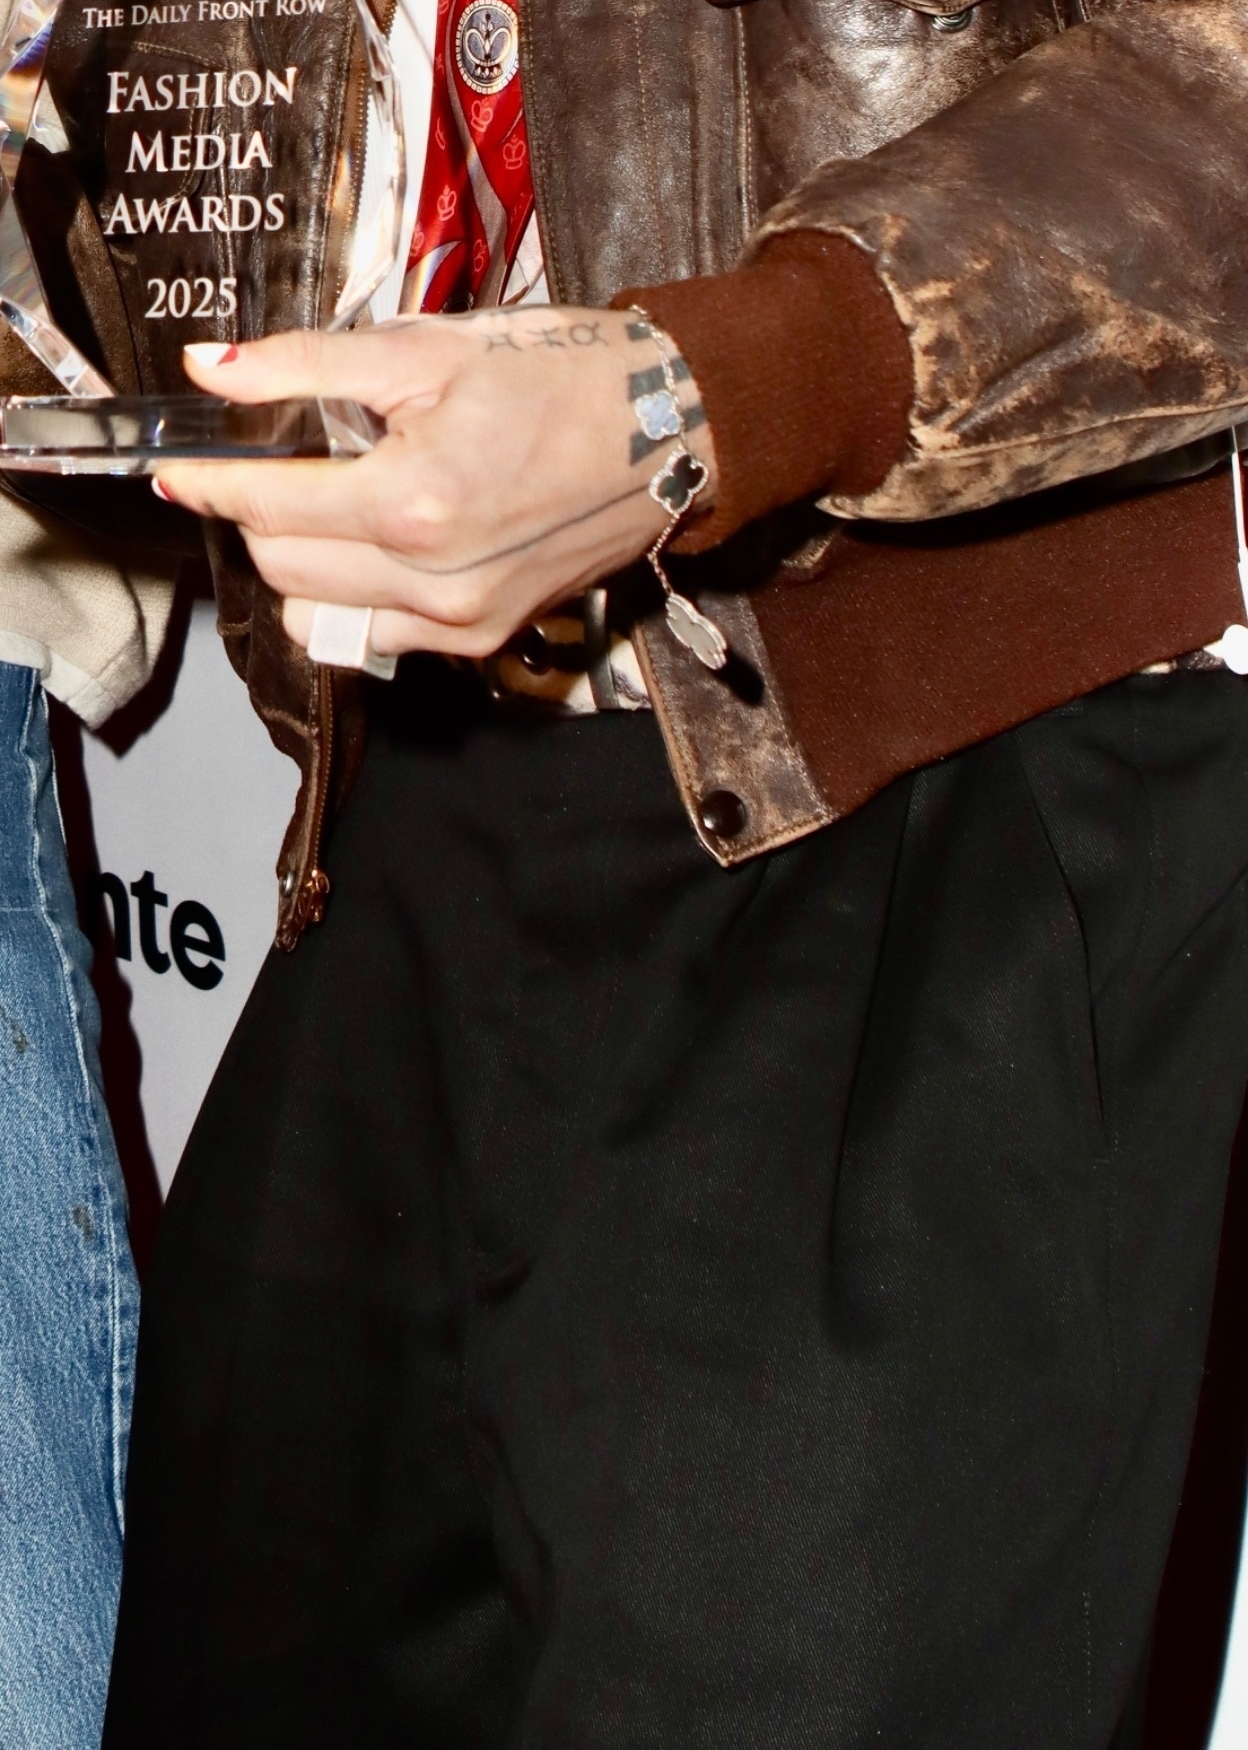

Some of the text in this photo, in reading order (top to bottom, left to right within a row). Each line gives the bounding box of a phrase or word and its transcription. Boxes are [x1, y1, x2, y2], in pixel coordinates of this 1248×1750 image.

[105, 66, 297, 114] FASHION
[125, 130, 273, 173] MEDIA
[103, 193, 285, 235] AWARDS
[144, 277, 238, 319] 2025
